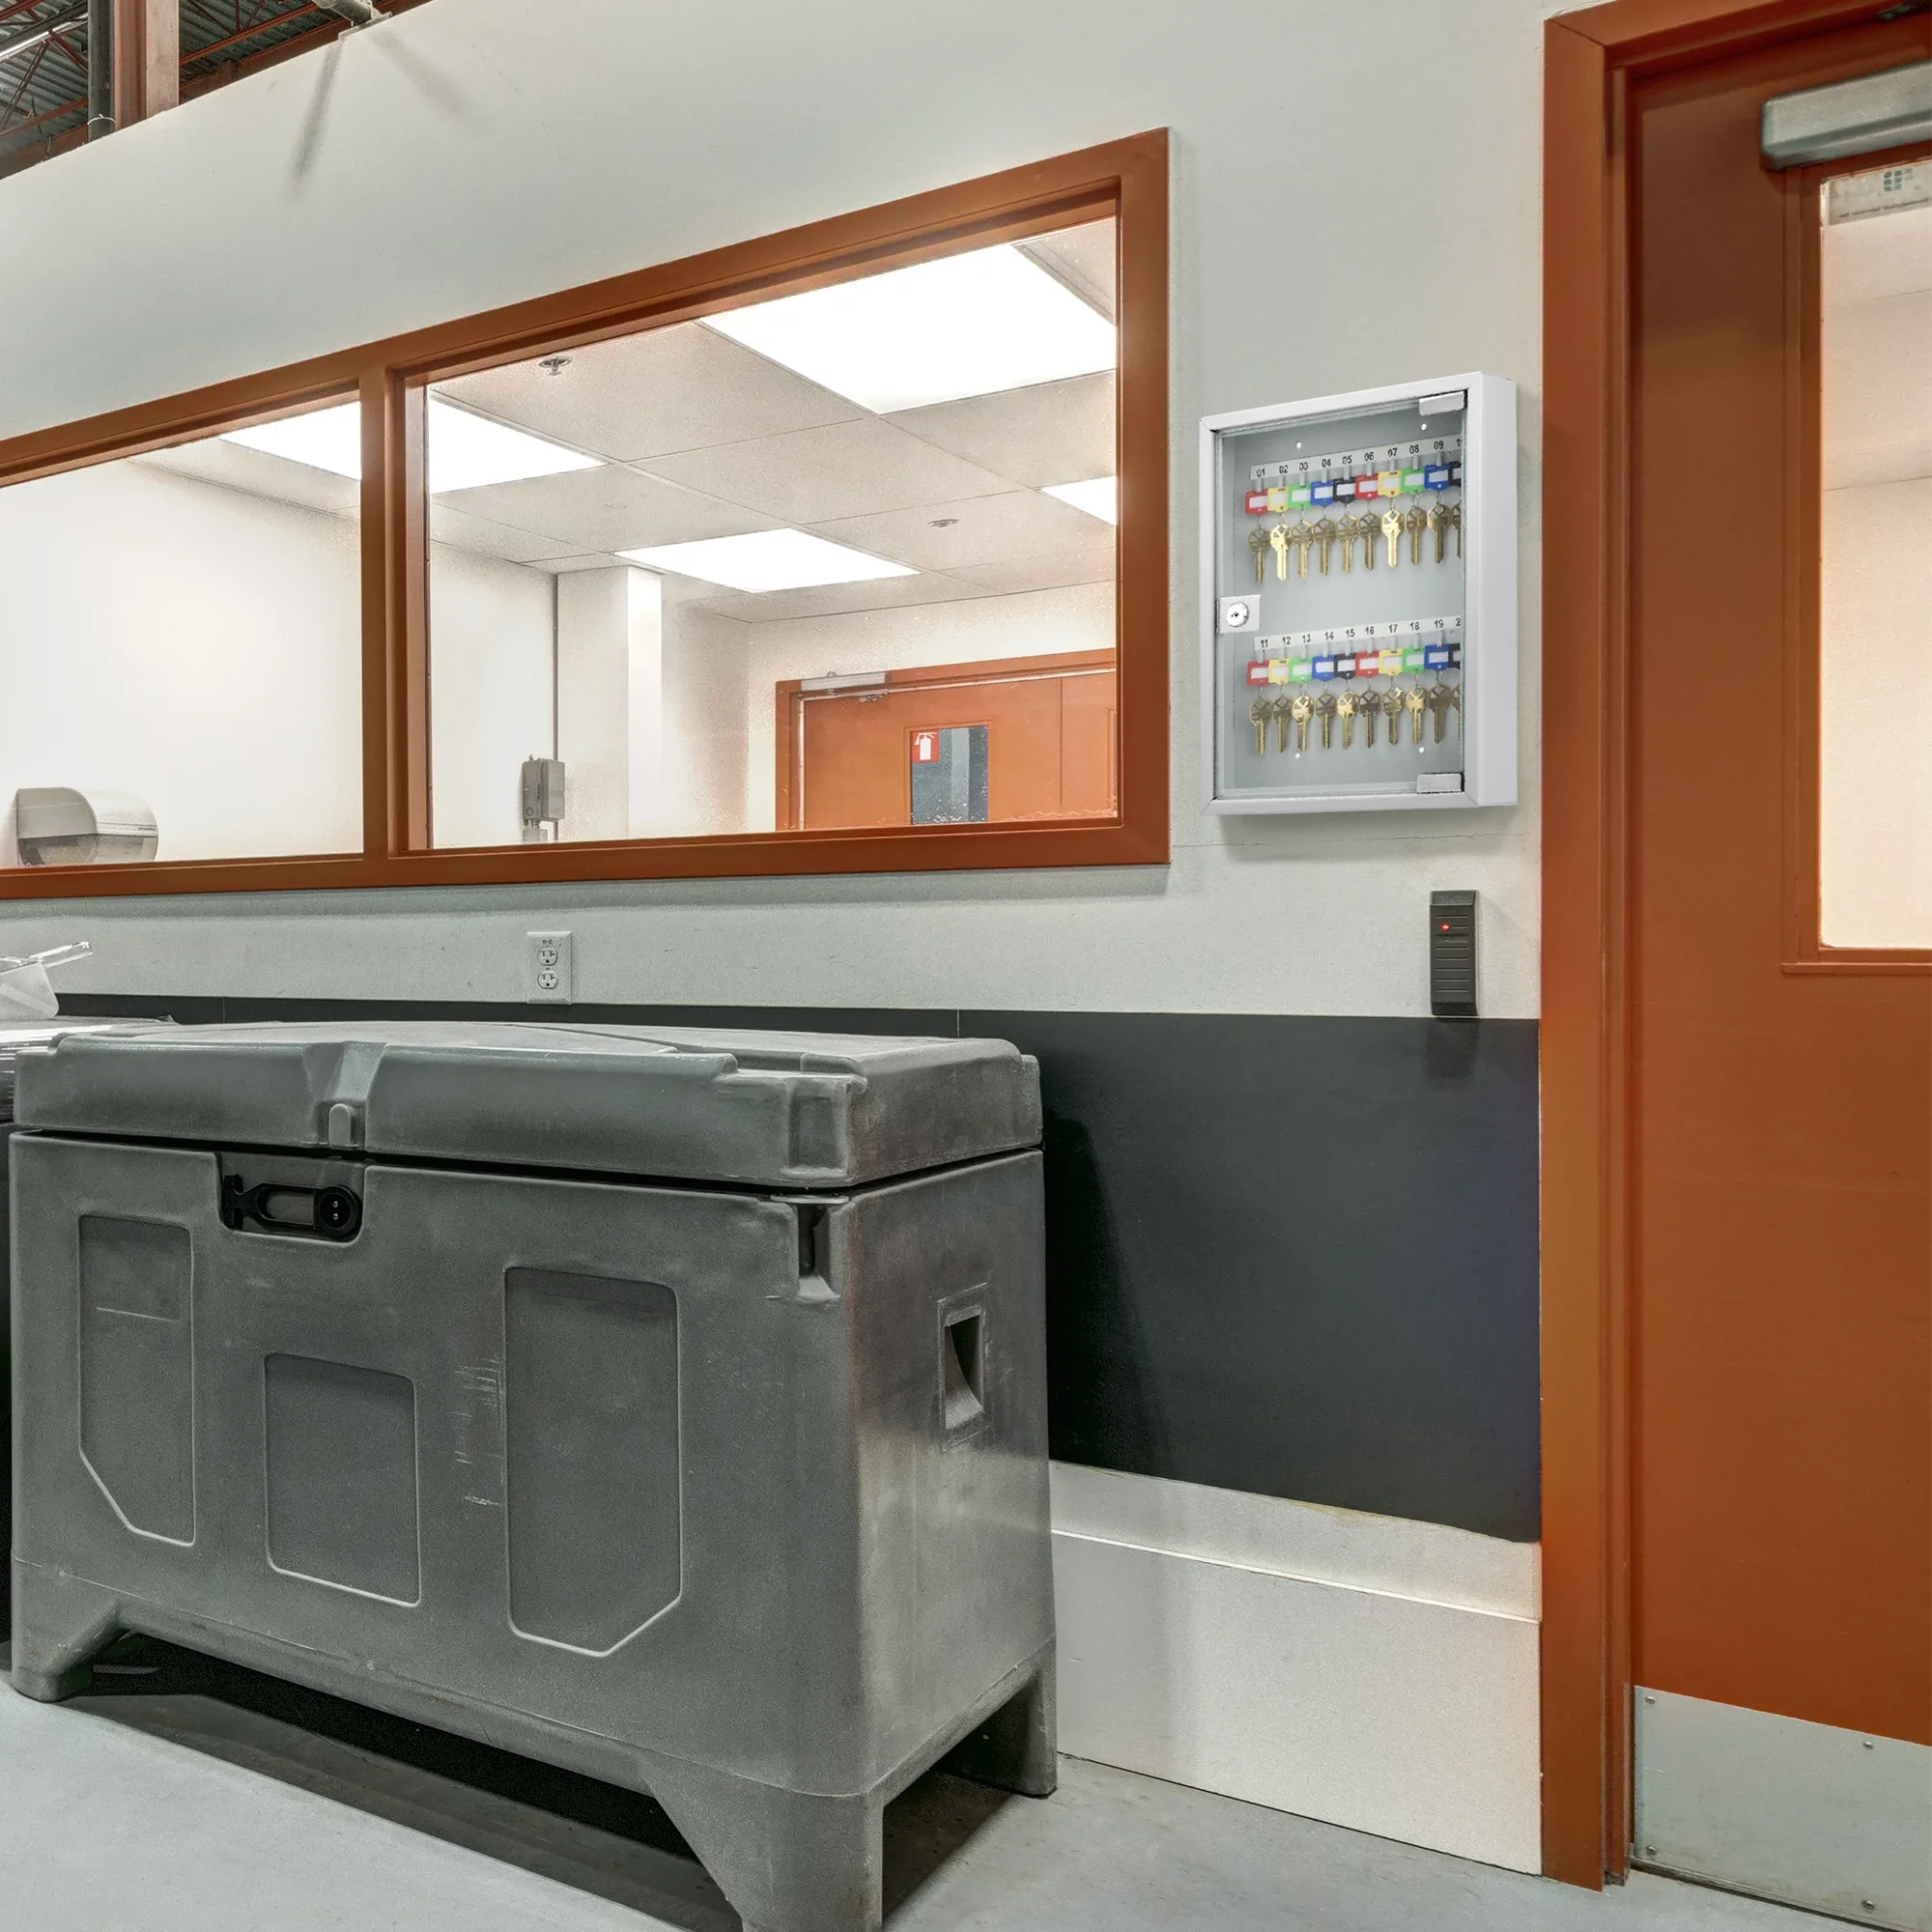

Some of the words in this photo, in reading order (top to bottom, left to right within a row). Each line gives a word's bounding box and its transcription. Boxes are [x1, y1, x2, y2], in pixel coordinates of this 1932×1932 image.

[1257, 469, 1265, 477] 01
[1279, 465, 1289, 474] 02
[1299, 462, 1309, 471] 03
[1321, 458, 1331, 468] 04
[1342, 455, 1352, 465] 05
[1364, 451, 1374, 461] 06
[1388, 447, 1398, 457] 07
[1409, 444, 1419, 454] 08
[1434, 440, 1444, 450] 09
[1456, 438, 1463, 447] 1
[1261, 639, 1268, 648] 11
[1282, 636, 1291, 645] 12
[1302, 634, 1311, 643] 13
[1324, 631, 1334, 640] 14
[1346, 628, 1355, 638] 15
[1365, 626, 1375, 636] 16
[1388, 624, 1398, 634] 17
[1409, 621, 1420, 631] 18
[1435, 619, 1444, 629] 19
[1456, 617, 1462, 627] 2
